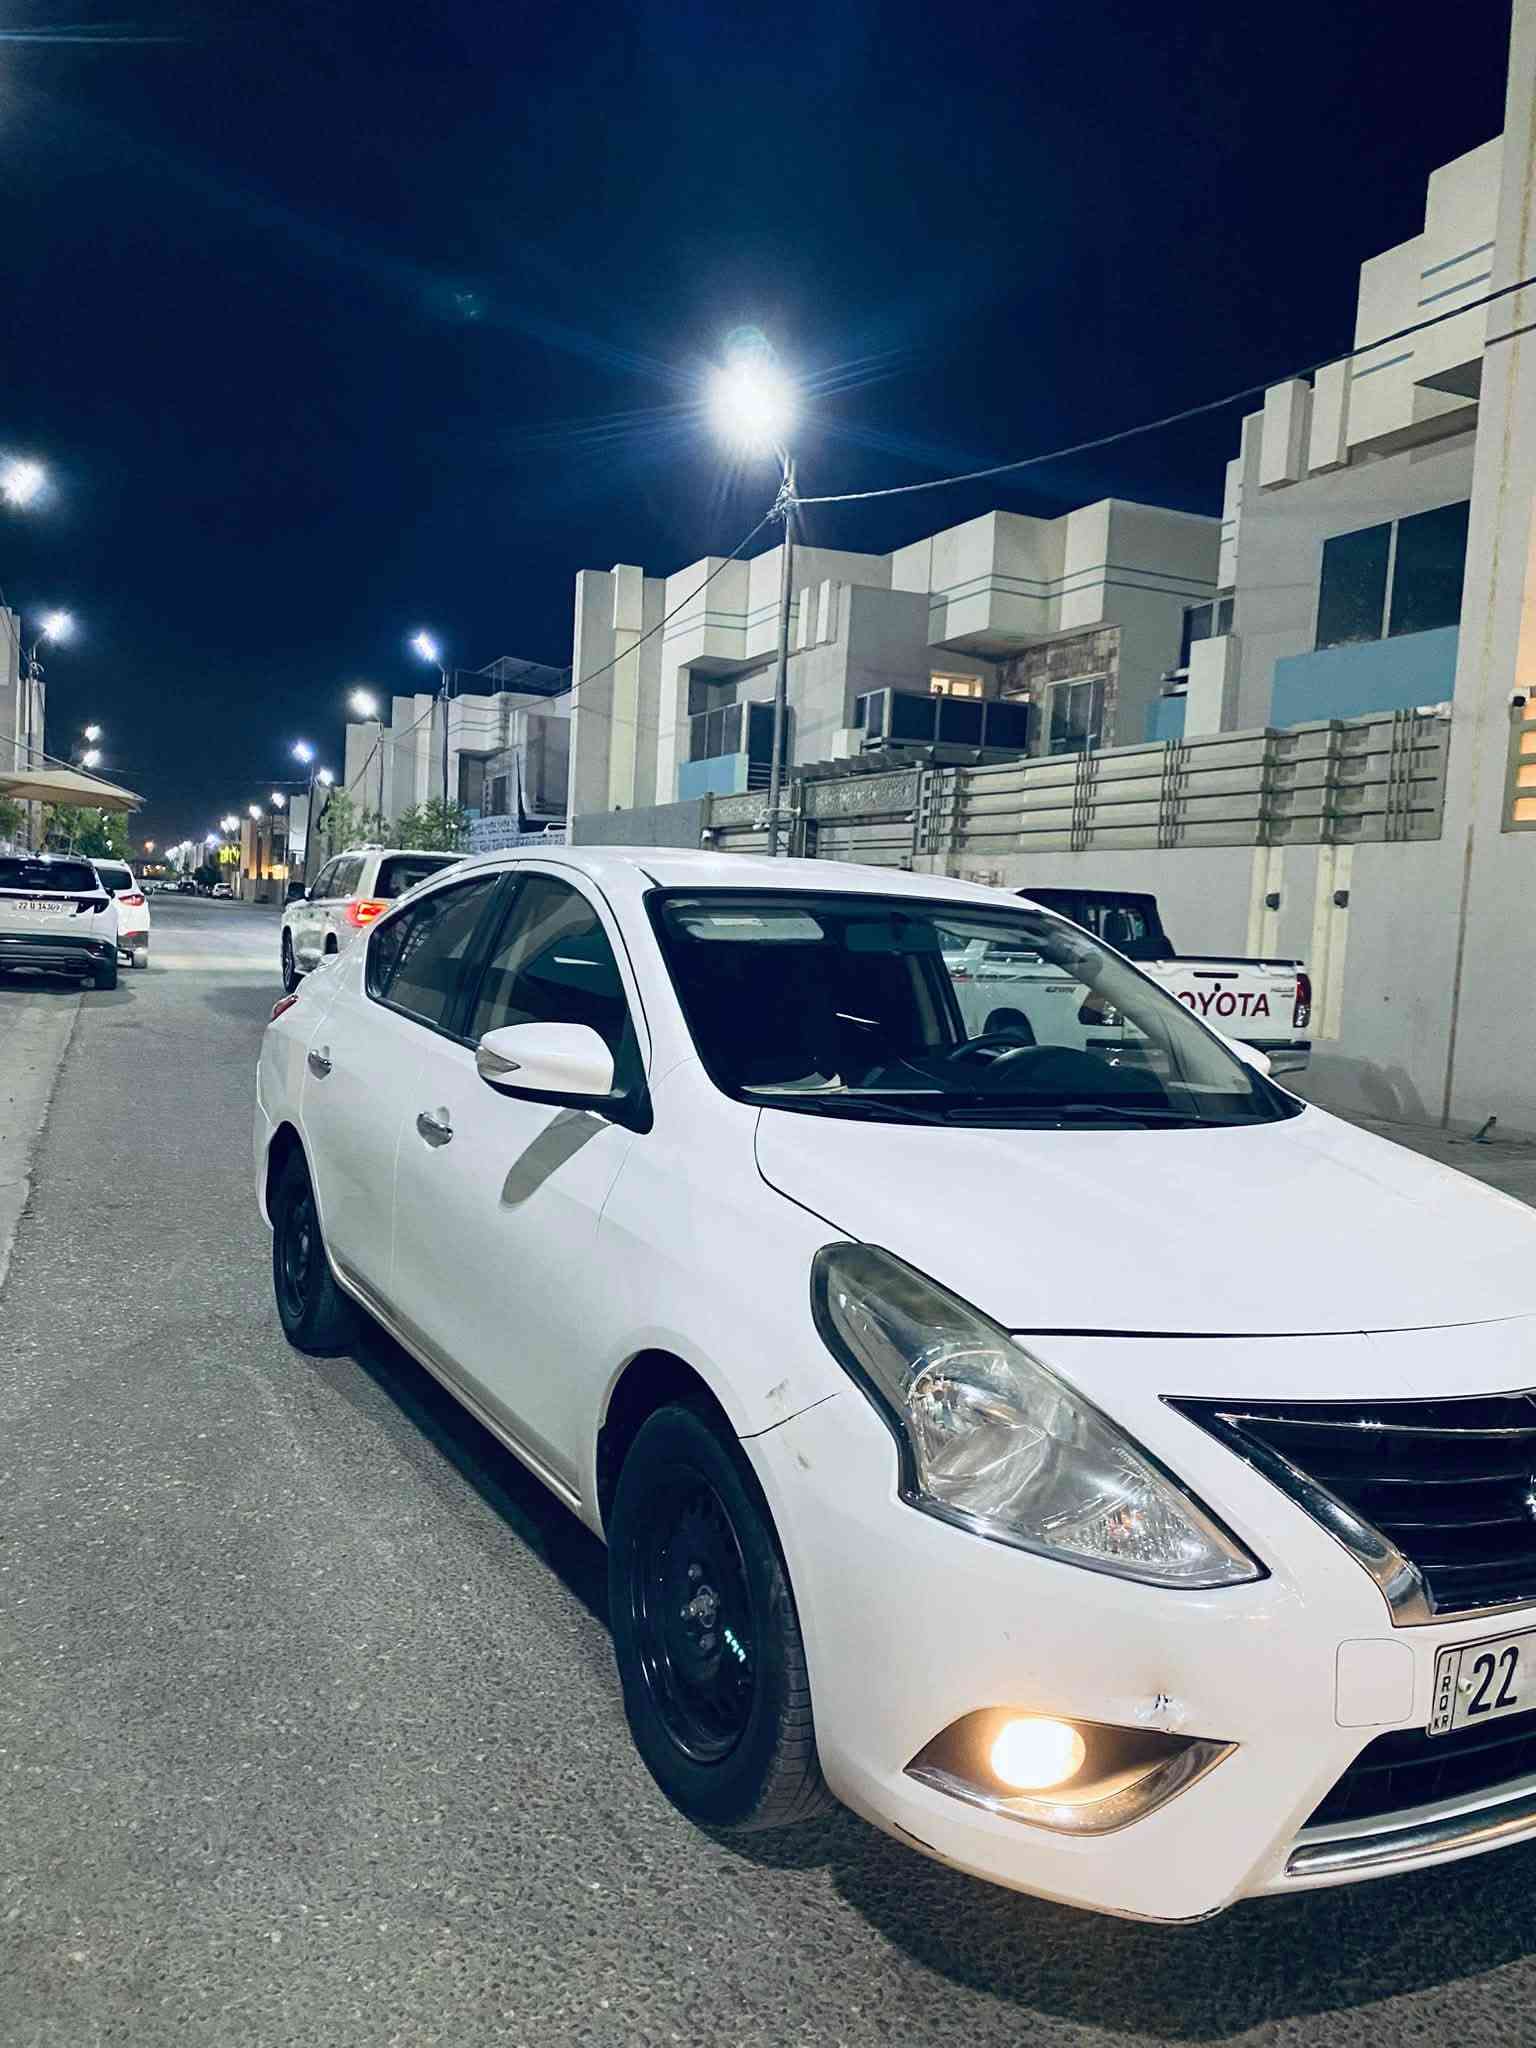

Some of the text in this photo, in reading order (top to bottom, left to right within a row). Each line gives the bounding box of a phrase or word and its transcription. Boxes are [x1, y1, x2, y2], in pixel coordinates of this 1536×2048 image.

[1172, 991, 1270, 1017] OYOTA
[1439, 1656, 1452, 1711] IRQ
[1467, 1646, 1519, 1716] 22
[1433, 1714, 1449, 1729] KR
